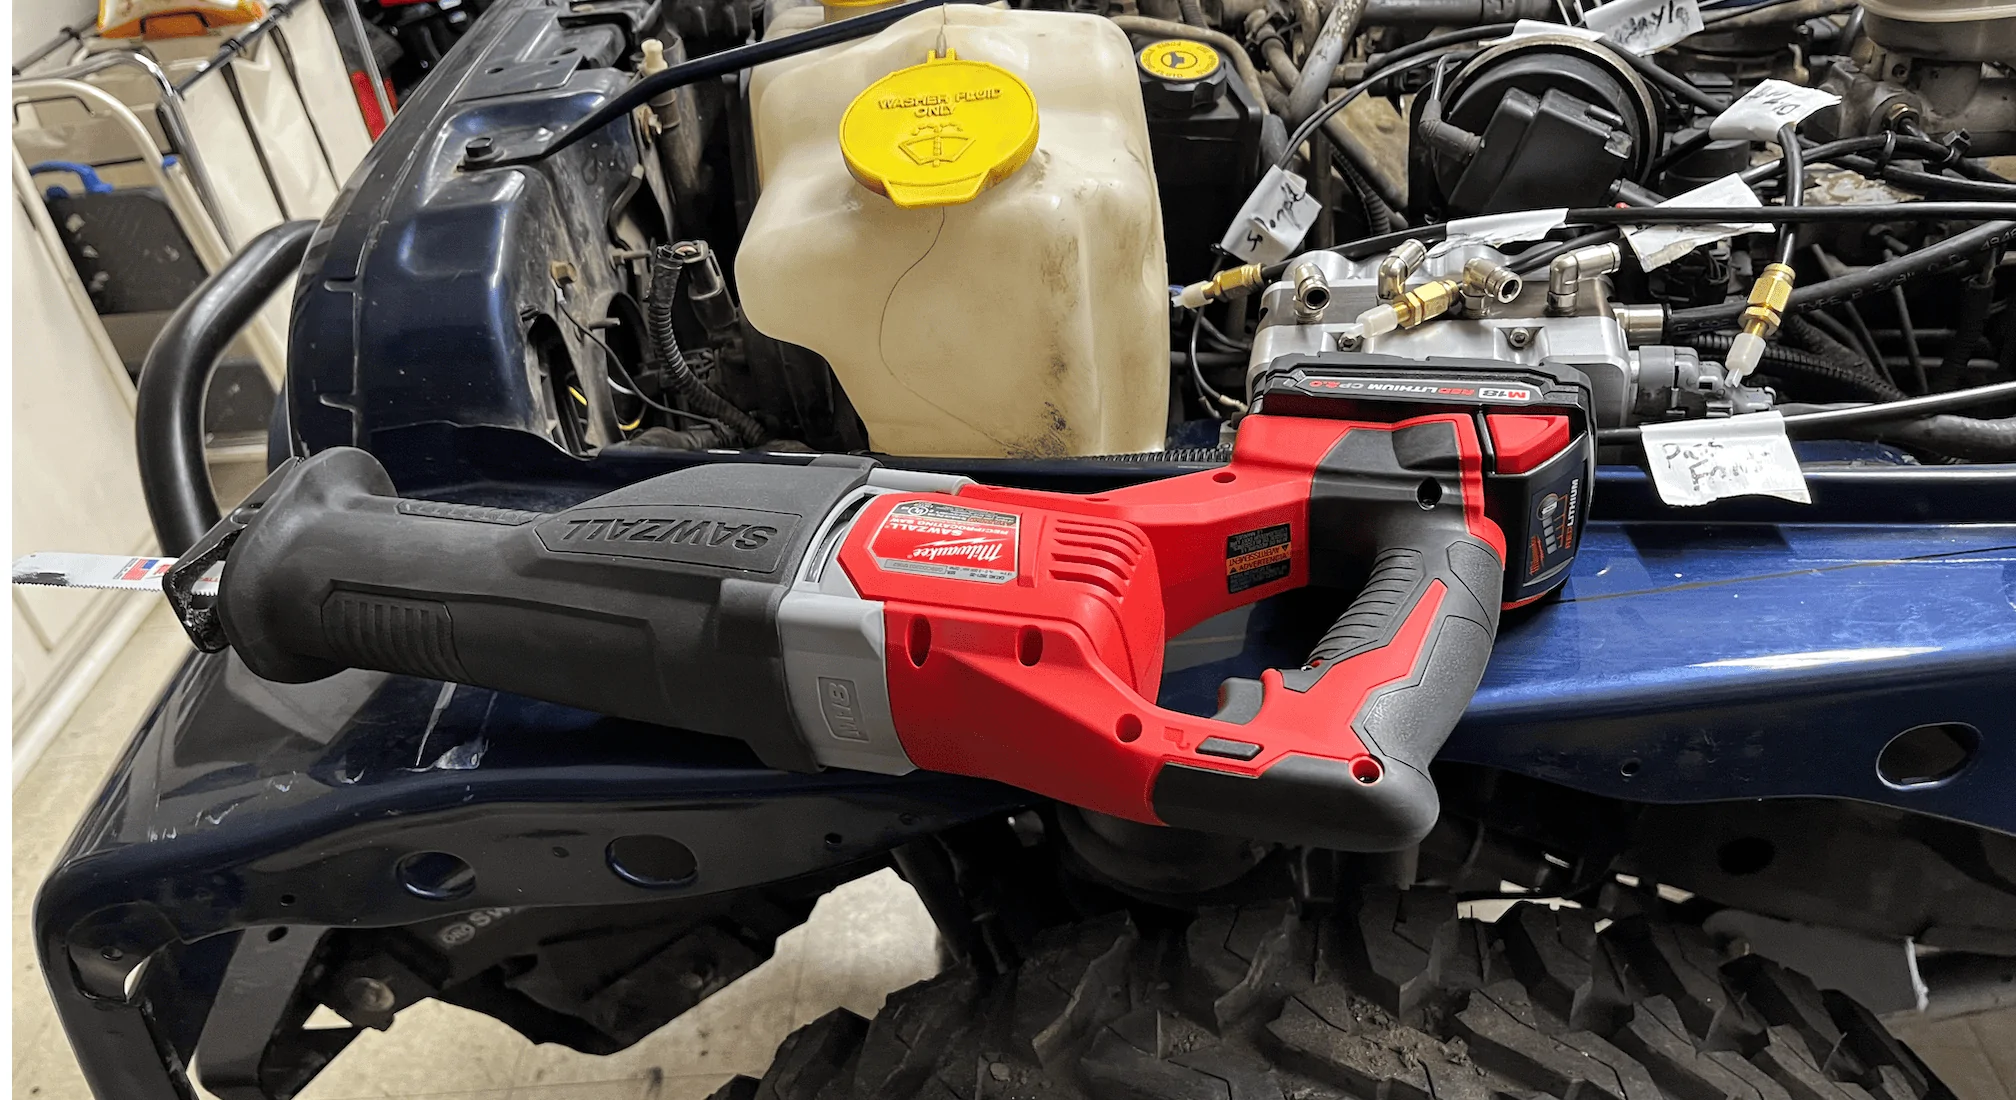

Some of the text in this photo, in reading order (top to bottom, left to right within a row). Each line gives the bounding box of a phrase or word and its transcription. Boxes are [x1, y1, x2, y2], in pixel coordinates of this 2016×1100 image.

[878, 88, 1001, 111] WASHER FLUID
[914, 106, 955, 118] ONLY
[1482, 389, 1527, 400] M18
[560, 518, 778, 550] SAWZALL
[889, 522, 963, 536] SAWZALL
[916, 520, 1009, 535] RECIPROCATING
[912, 542, 1003, 562] Milwaukee
[828, 682, 860, 736] M18
